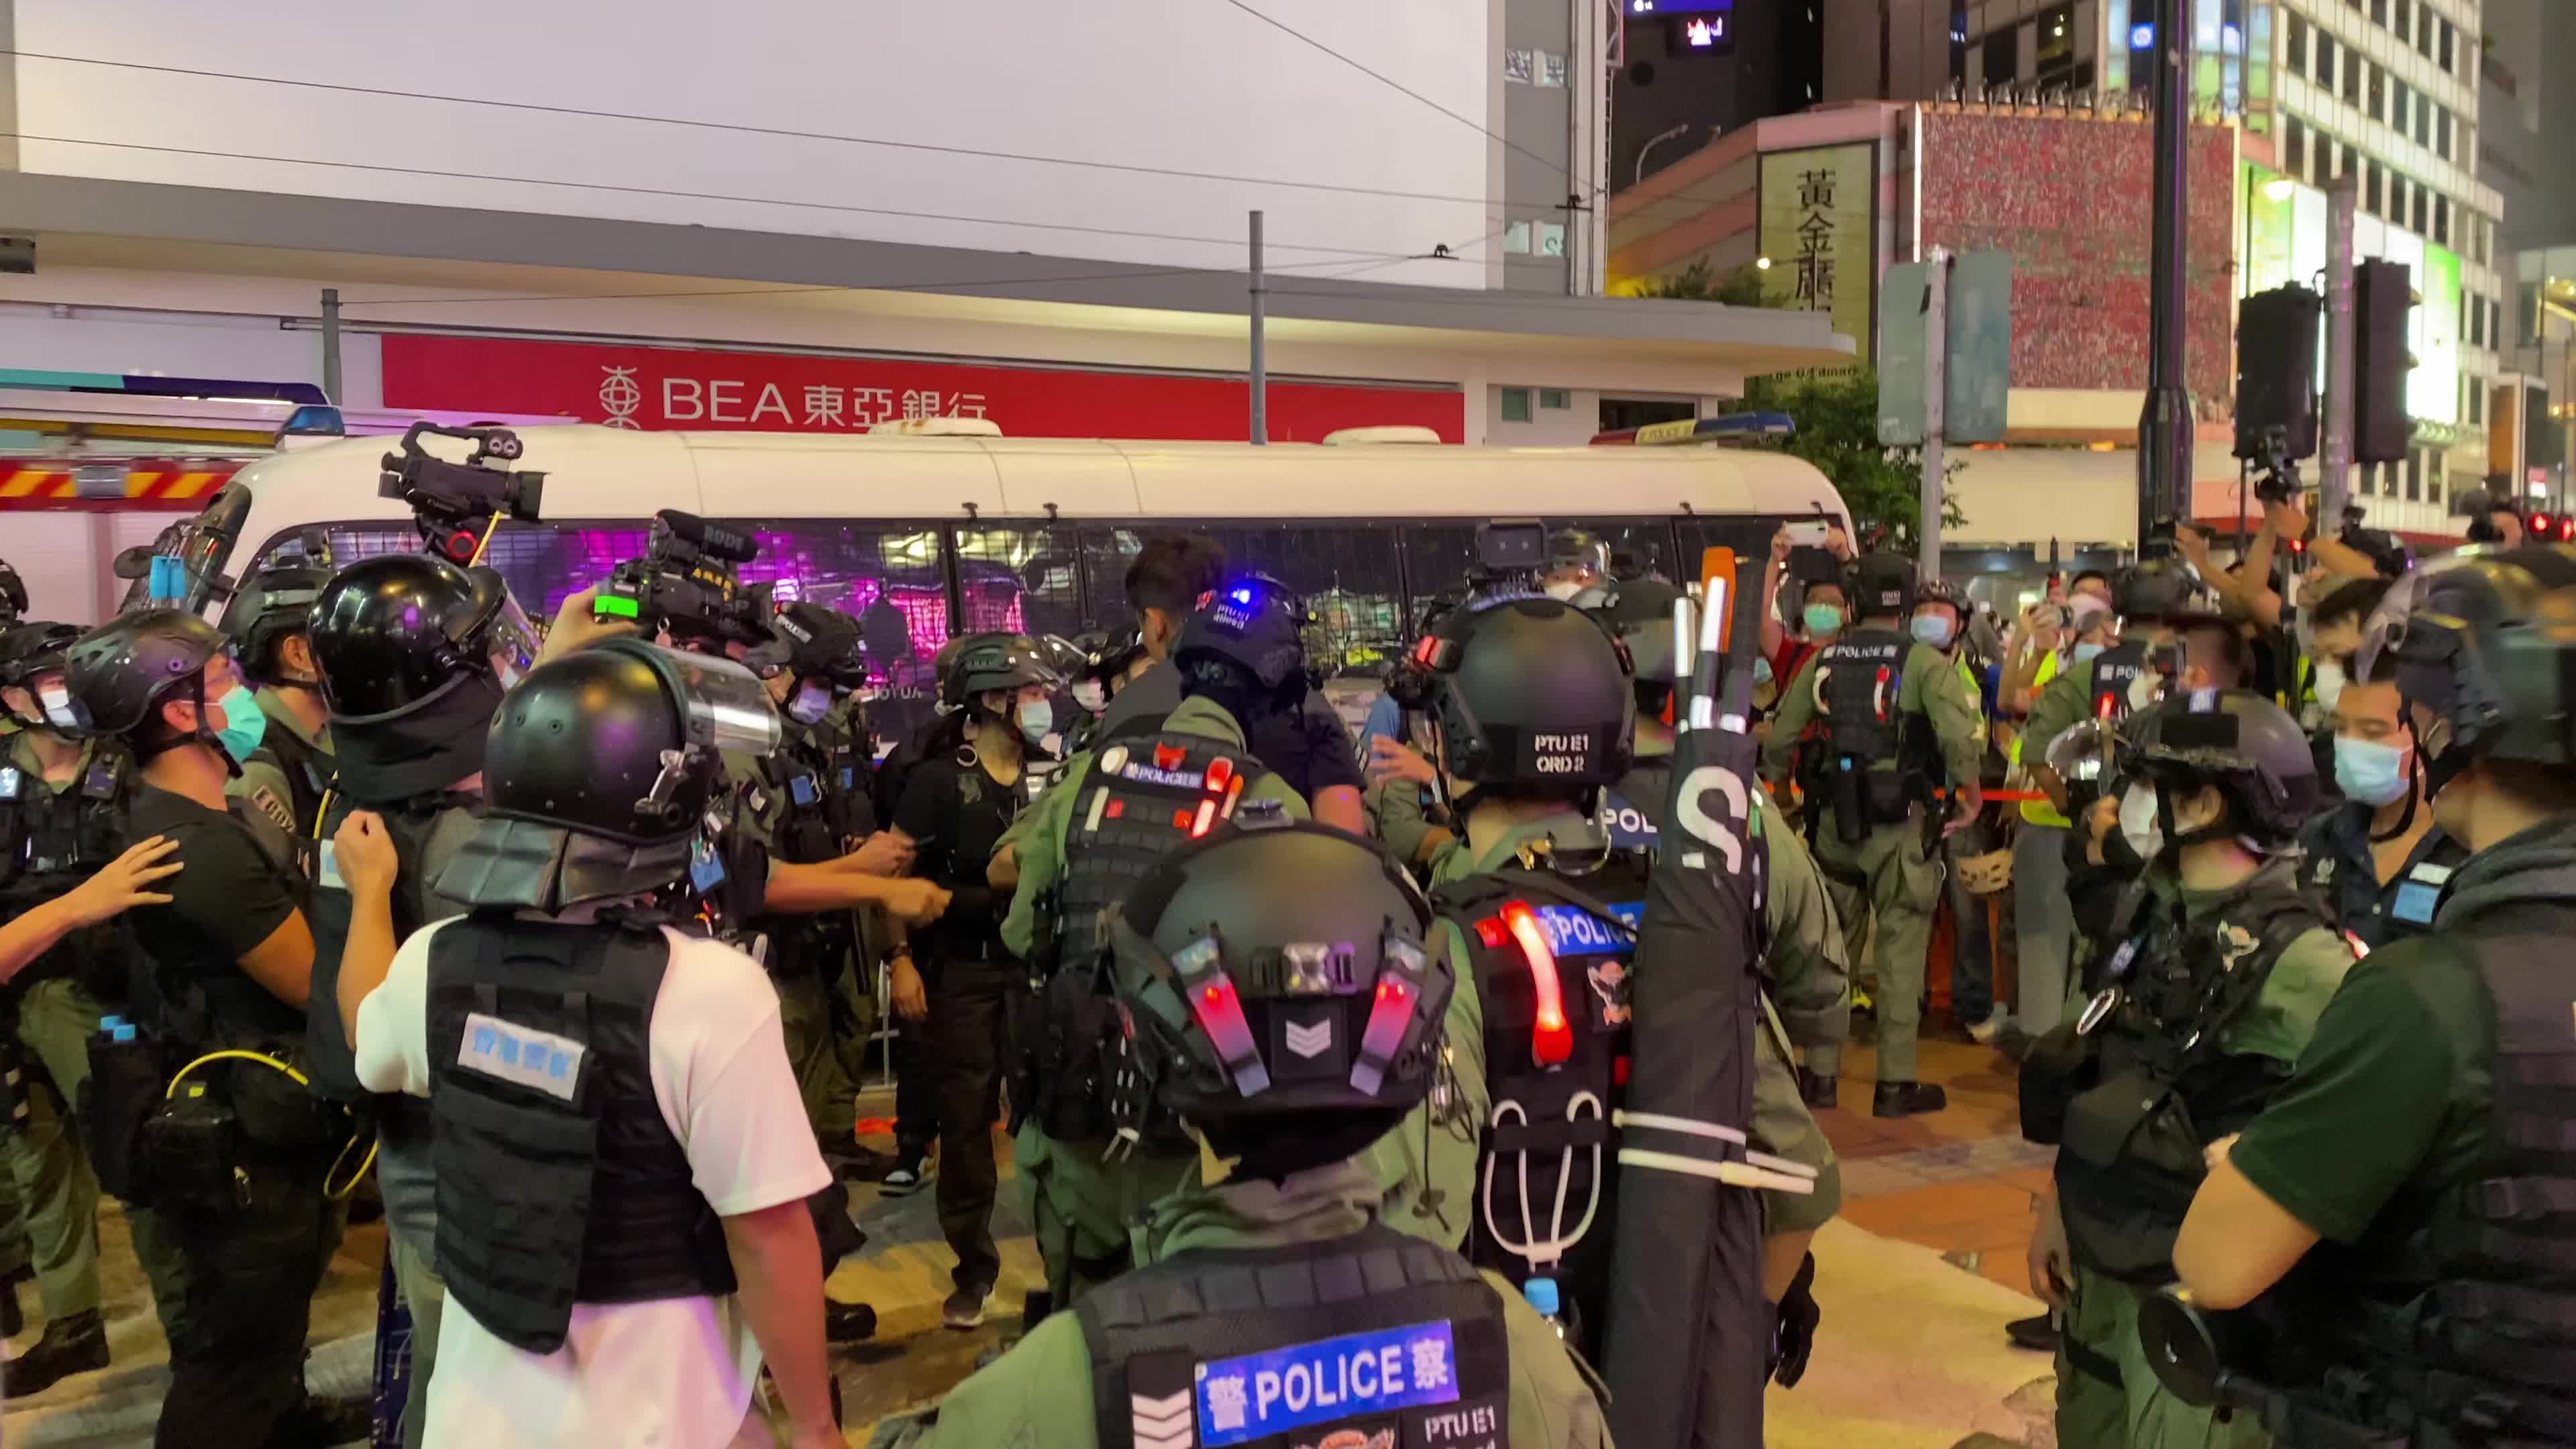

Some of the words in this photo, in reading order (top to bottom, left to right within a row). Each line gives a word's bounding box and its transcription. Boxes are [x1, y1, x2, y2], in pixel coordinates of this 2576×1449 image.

[1794, 168, 1837, 313] 黃金廣
[663, 378, 793, 425] BEA
[802, 384, 987, 428] 東亞銀行
[1837, 645, 1881, 659] POLICE
[1535, 735, 1568, 752] PTU
[1570, 734, 1589, 752] E1
[1536, 755, 1572, 773] ORD
[1255, 1344, 1405, 1421] POLICE
[1425, 1408, 1469, 1443] PTU
[1472, 1405, 1495, 1436] E1
